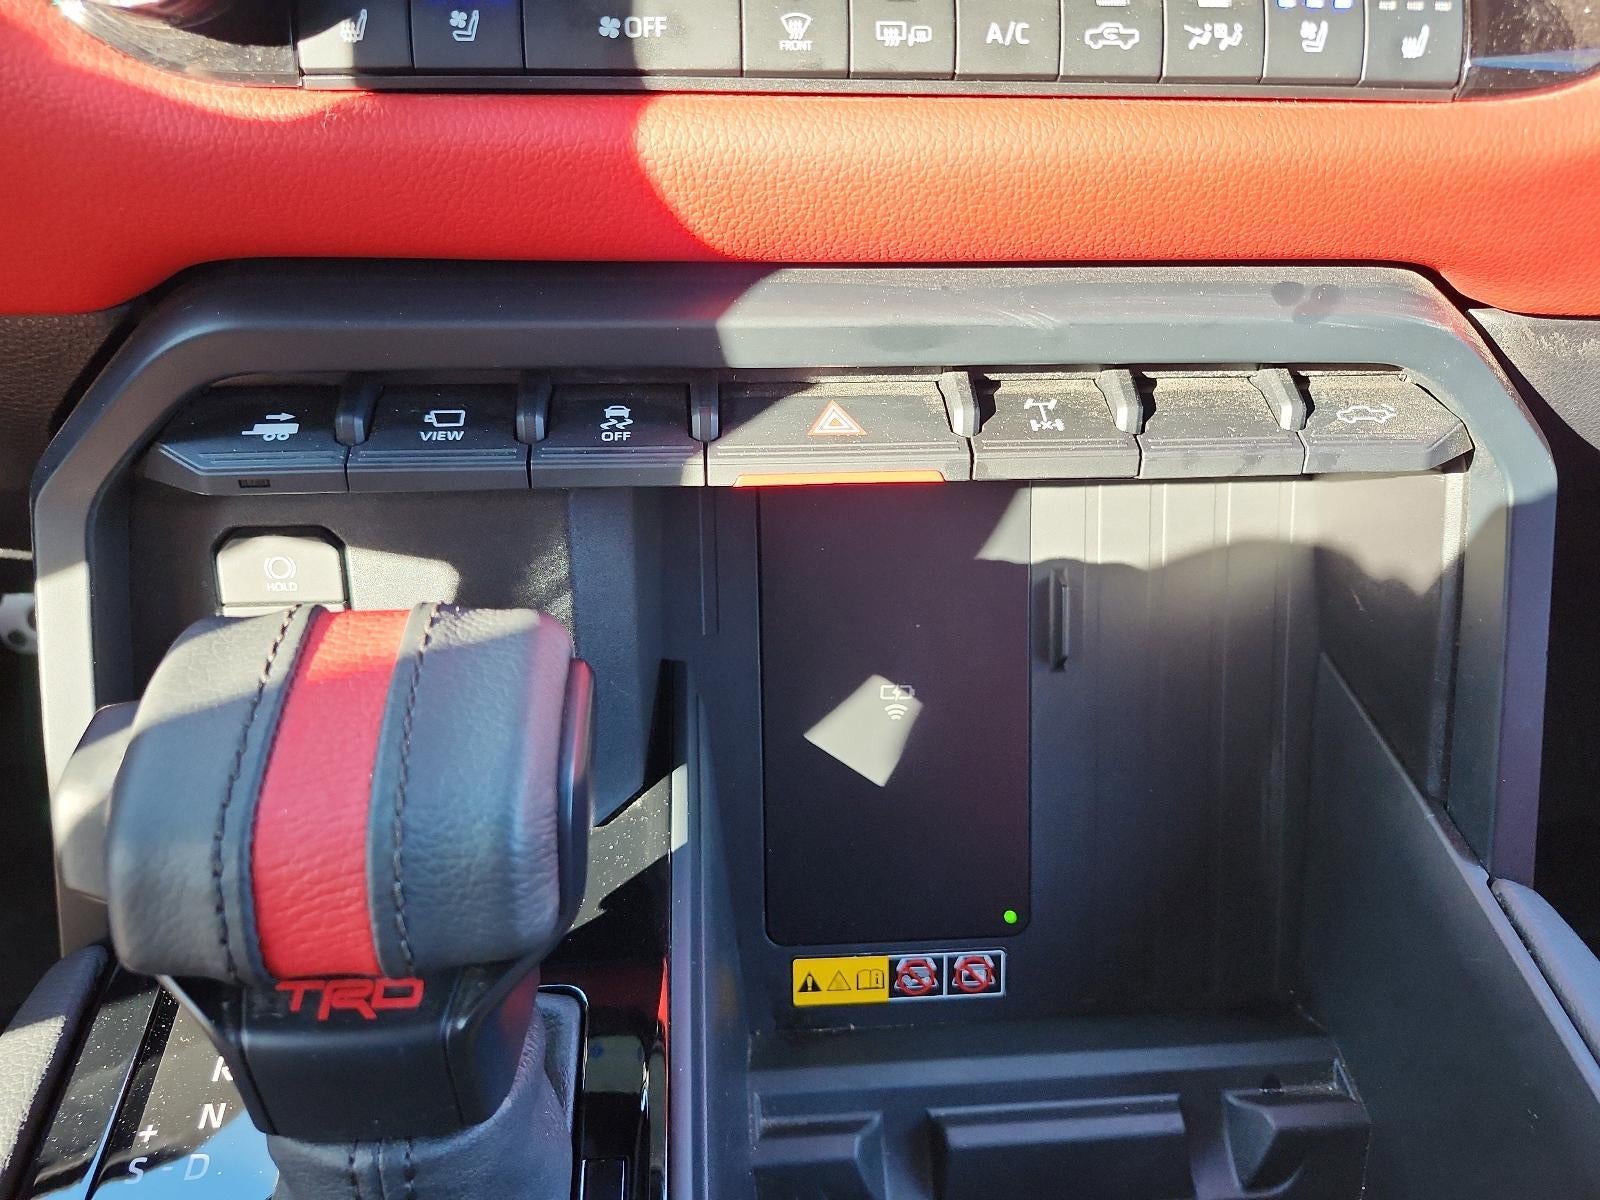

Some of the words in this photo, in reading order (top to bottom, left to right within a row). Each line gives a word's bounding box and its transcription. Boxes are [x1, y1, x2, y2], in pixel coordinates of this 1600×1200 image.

[624, 16, 667, 38] OFF
[986, 21, 1030, 46] A/C
[779, 40, 812, 51] FRONT
[420, 430, 464, 441] VIEW
[601, 431, 631, 441] OFF
[266, 582, 297, 591] HOLD
[275, 978, 424, 1021] TRD
[198, 1102, 227, 1129] N
[125, 1156, 147, 1184] S
[184, 1153, 210, 1181] D
